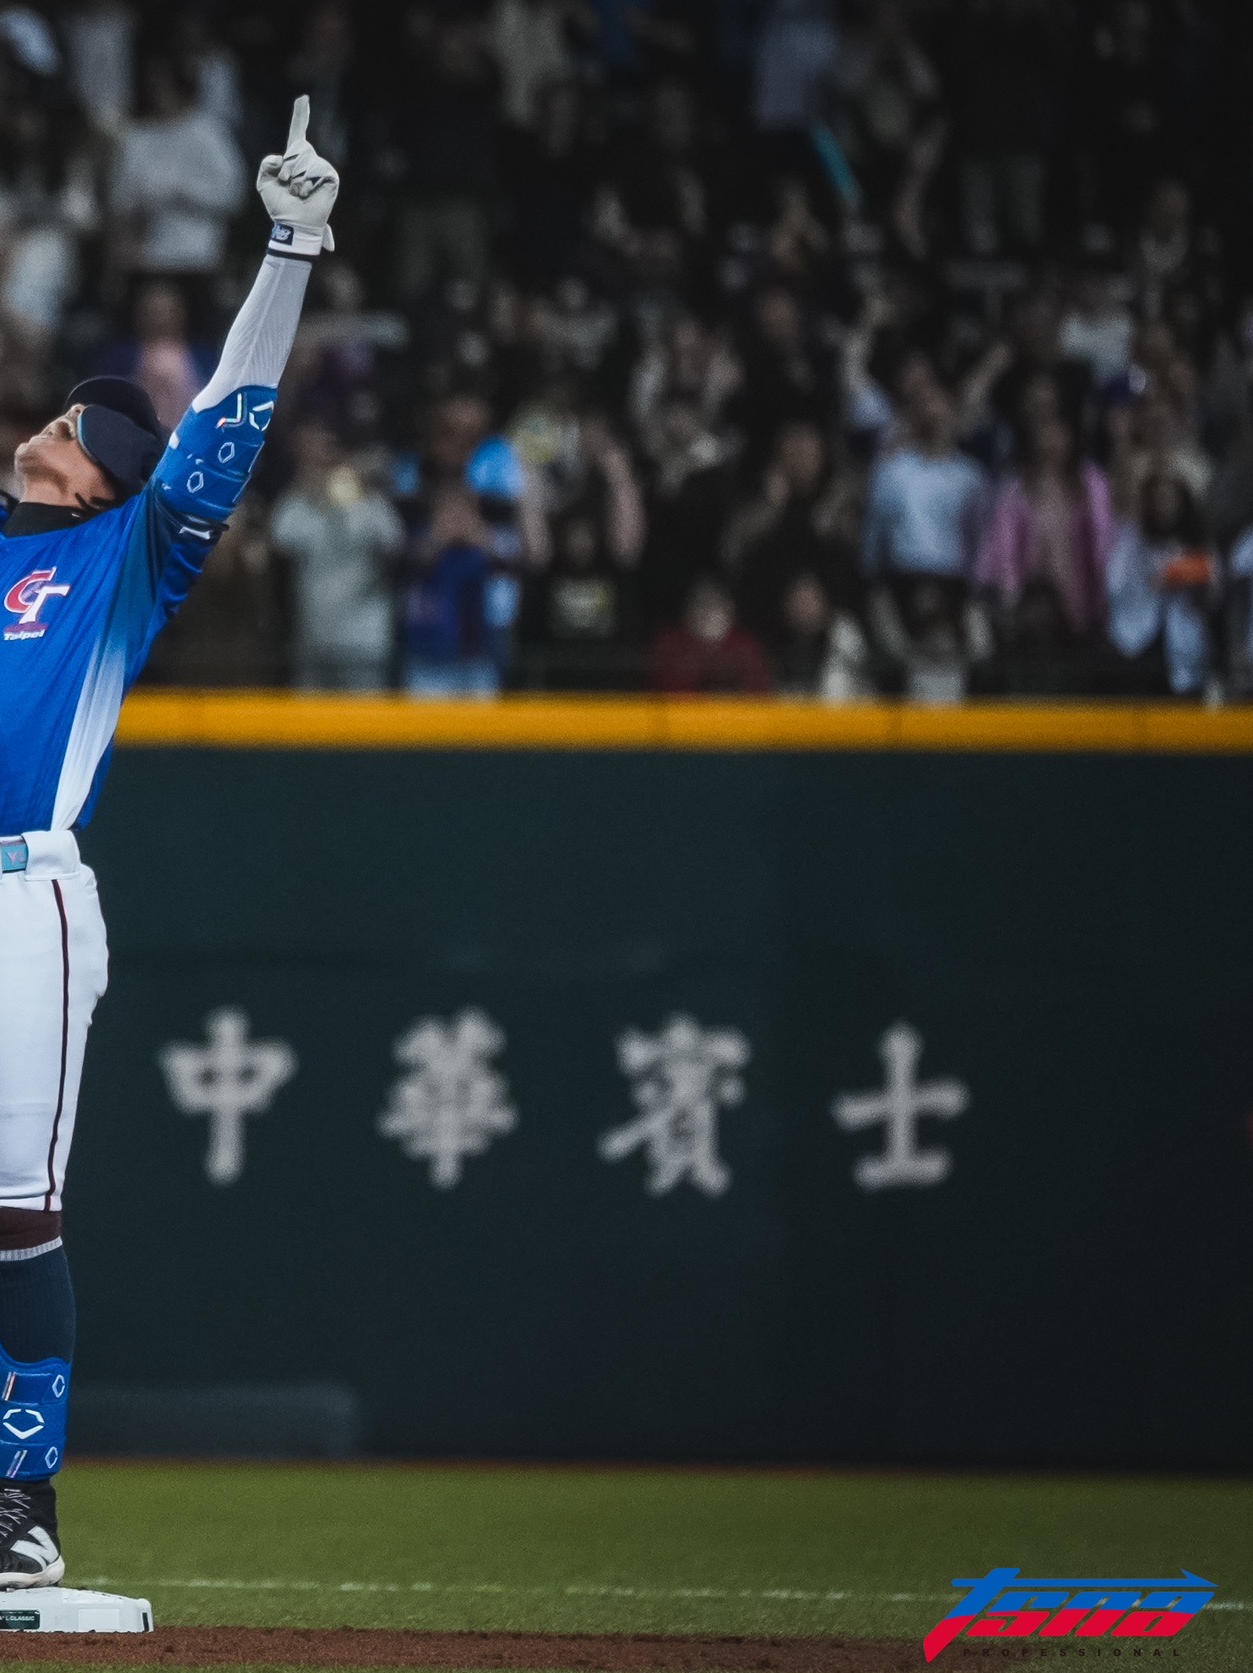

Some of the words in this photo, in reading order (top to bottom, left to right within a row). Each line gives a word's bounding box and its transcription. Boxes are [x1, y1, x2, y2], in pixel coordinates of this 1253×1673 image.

[3, 629, 46, 641] Taipei
[159, 1006, 972, 1195] 中華賓士
